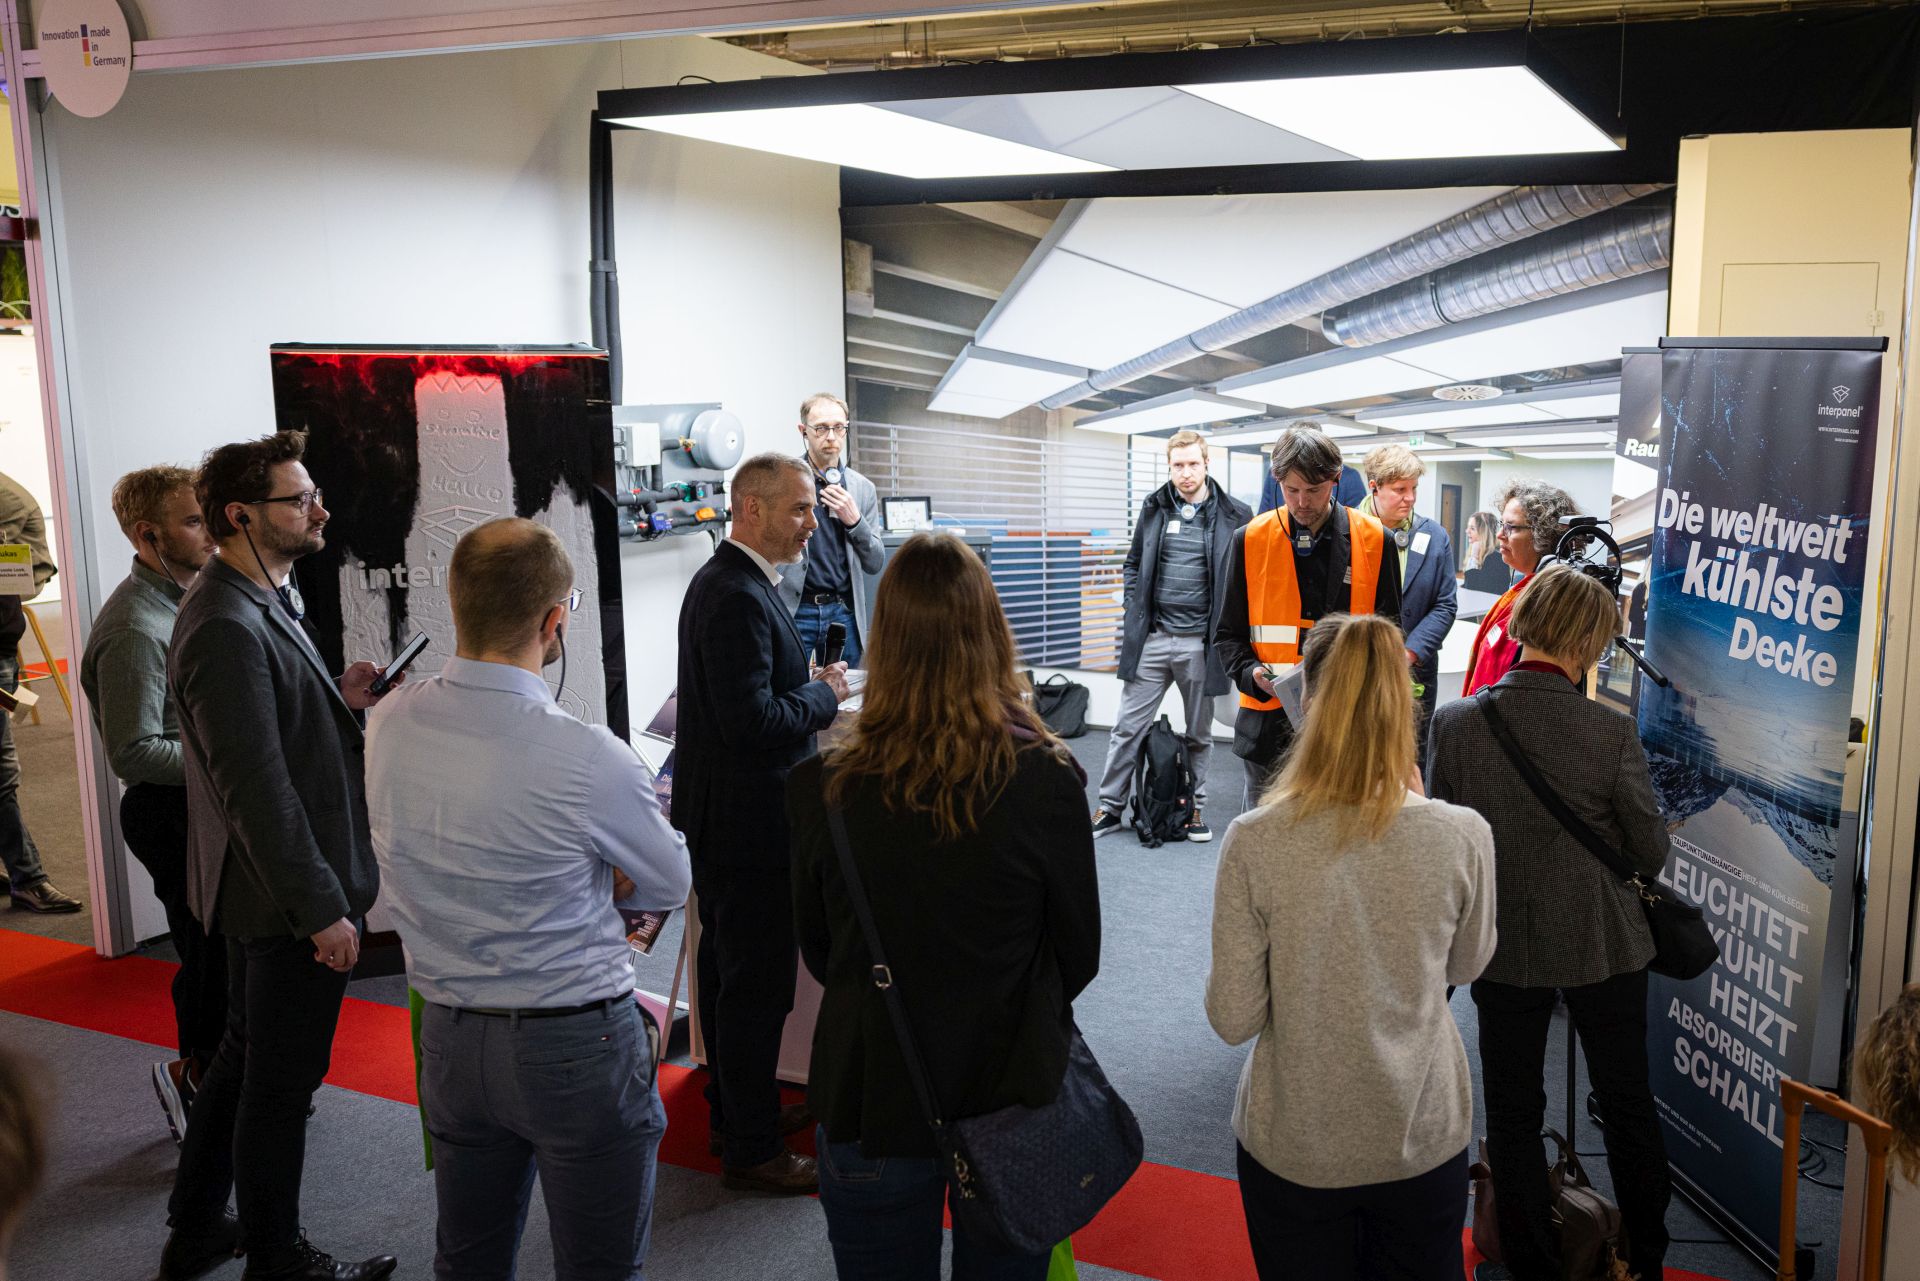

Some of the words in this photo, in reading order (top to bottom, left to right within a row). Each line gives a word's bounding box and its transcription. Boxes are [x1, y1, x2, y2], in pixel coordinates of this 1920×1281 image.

[42, 29, 79, 40] Innovation
[91, 26, 110, 37] made
[92, 42, 99, 51] in
[93, 56, 126, 67] Germany
[1657, 488, 1704, 534] Die
[1710, 503, 1853, 564] weltweit
[358, 560, 449, 590] inter
[1681, 540, 1844, 631] kühlste
[1728, 616, 1838, 687] Decke
[1658, 856, 1808, 960] LEUCHTET
[1673, 837, 1742, 877] TAUPUNKTUNABHÄNGIGE
[1759, 881, 1771, 894] UND
[1771, 885, 1810, 914] KÜHLSEGEL
[1707, 922, 1803, 1008] KÜHLT
[1709, 972, 1798, 1057] HEIZT
[1673, 1036, 1784, 1150] SCHALL
